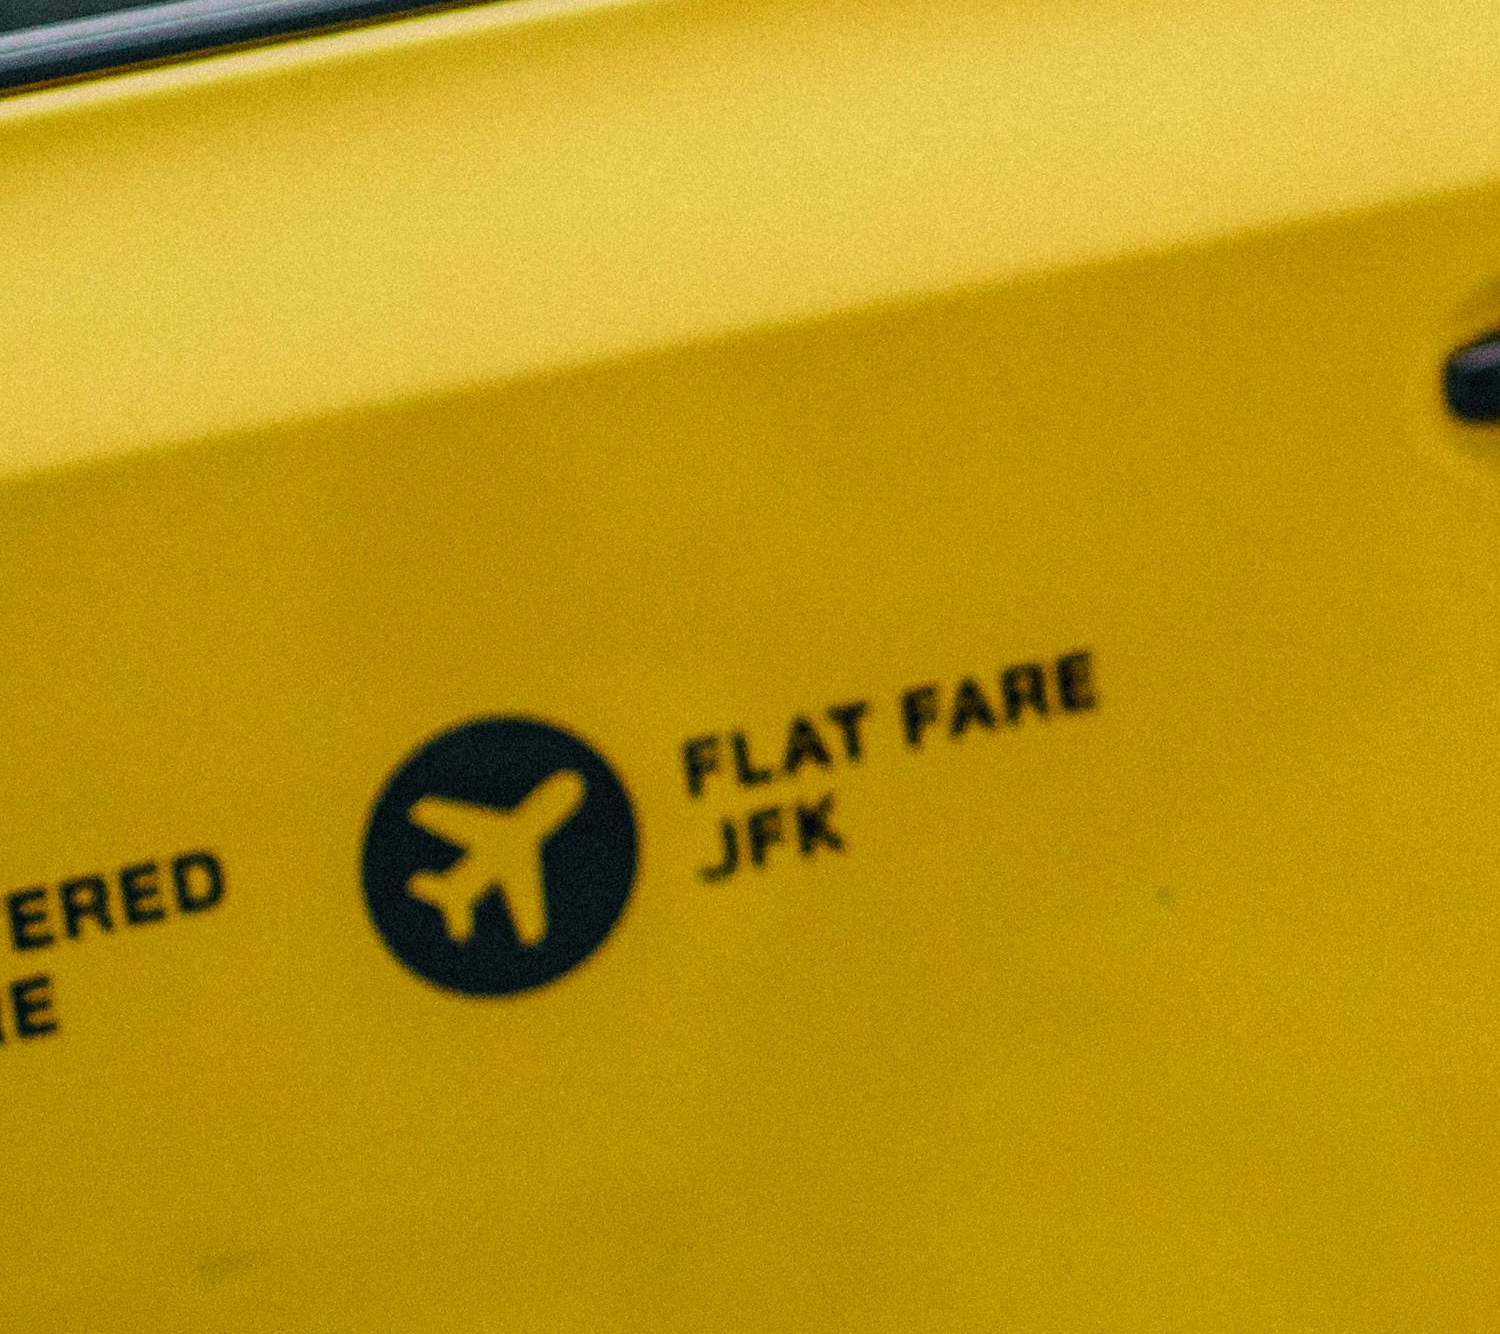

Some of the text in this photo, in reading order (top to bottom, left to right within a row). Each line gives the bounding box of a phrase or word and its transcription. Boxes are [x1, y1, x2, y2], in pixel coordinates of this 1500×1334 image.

[682, 650, 1097, 800] FLAT FARE
[699, 793, 845, 882] JFK
[6, 851, 223, 950] ERED
[0, 976, 57, 1043] E
